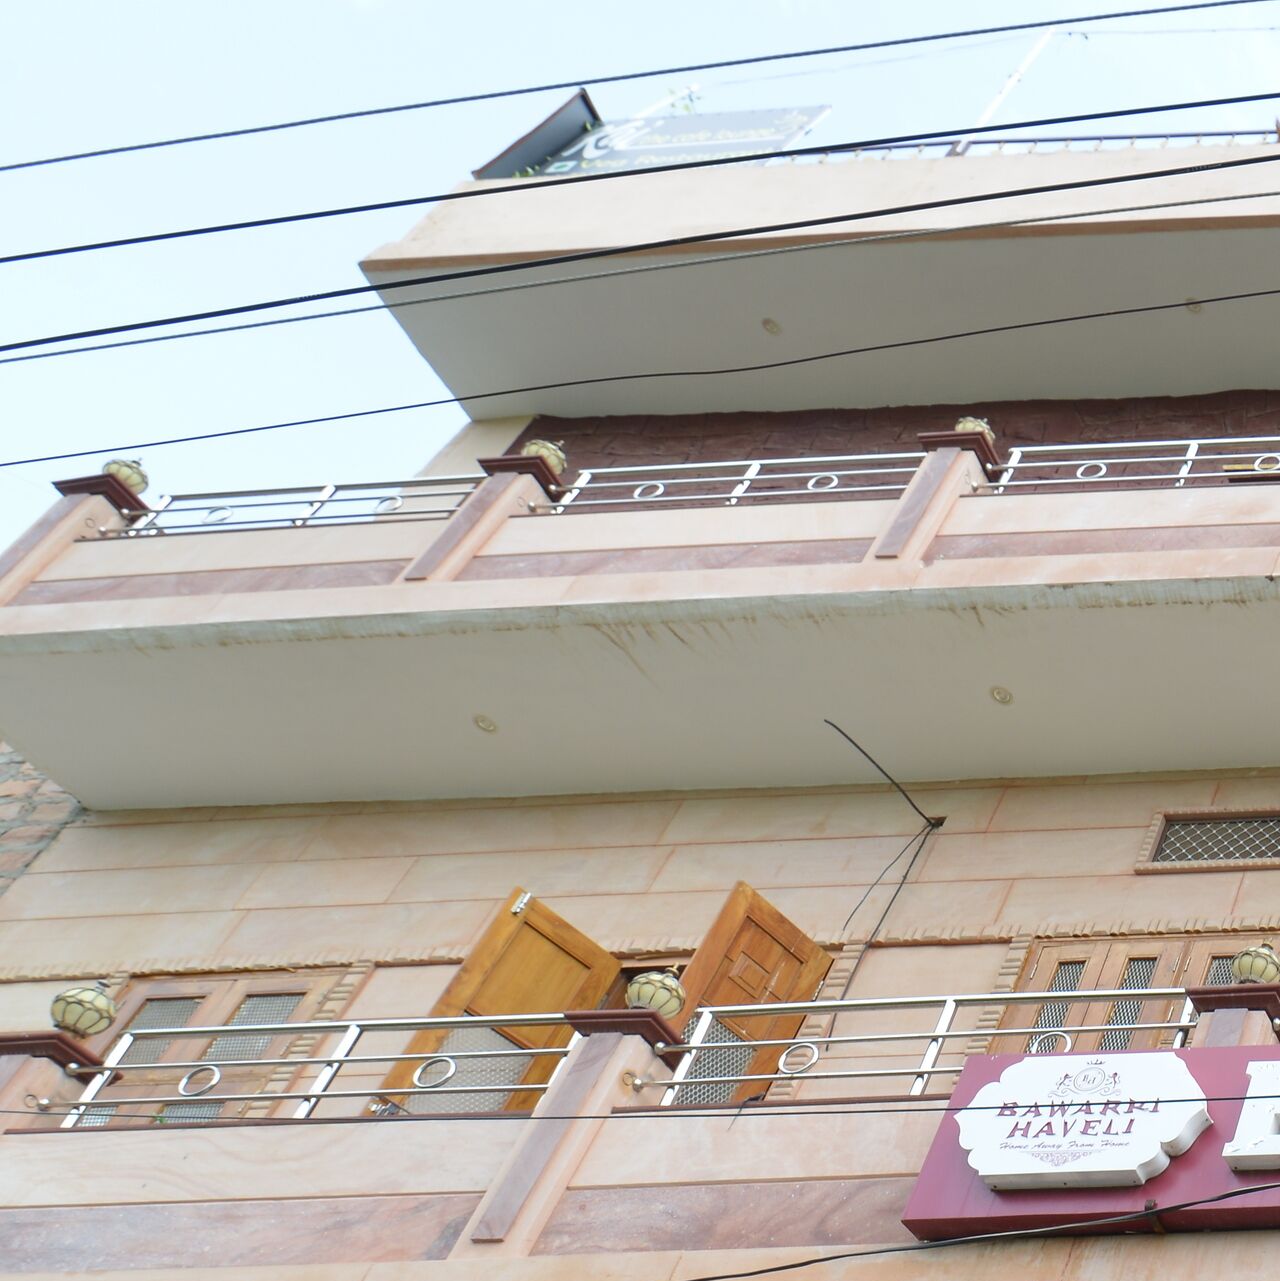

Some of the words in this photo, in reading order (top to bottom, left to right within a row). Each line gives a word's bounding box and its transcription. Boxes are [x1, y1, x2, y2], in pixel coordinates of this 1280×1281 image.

[997, 1097, 1161, 1118] BAWARRI
[1006, 1118, 1135, 1139] HAVELI
[999, 1141, 1029, 1150] Home
[1101, 1139, 1130, 1148] Home
